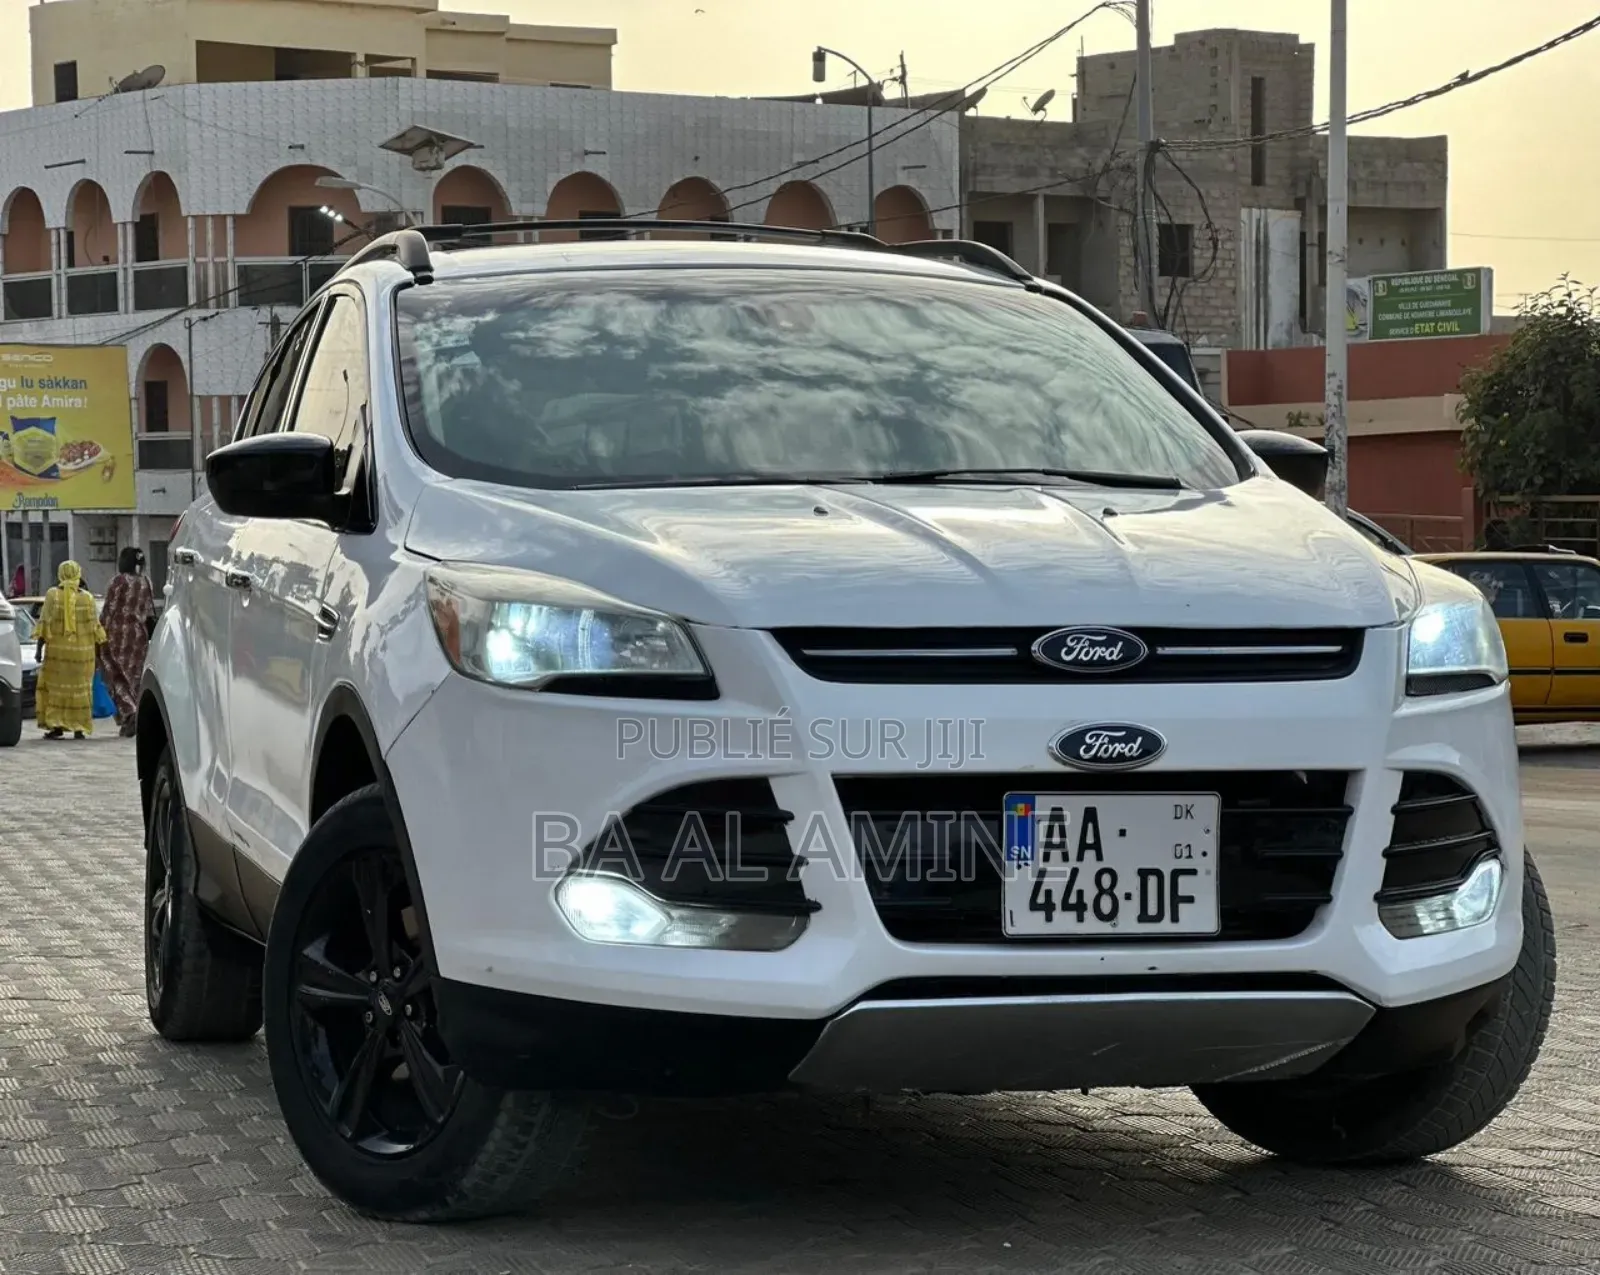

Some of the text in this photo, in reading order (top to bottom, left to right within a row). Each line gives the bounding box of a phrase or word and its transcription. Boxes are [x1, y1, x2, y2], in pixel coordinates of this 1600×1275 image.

[1378, 311, 1403, 320] COMMUNE
[1403, 310, 1410, 319] DE
[1437, 320, 1460, 333] CIVIL
[20, 375, 34, 389] lu
[7, 394, 37, 410] pâte
[1060, 634, 1123, 661] Ford
[1079, 730, 1143, 759] Ford
[1173, 804, 1195, 820] DK
[1010, 845, 1031, 859] SN
